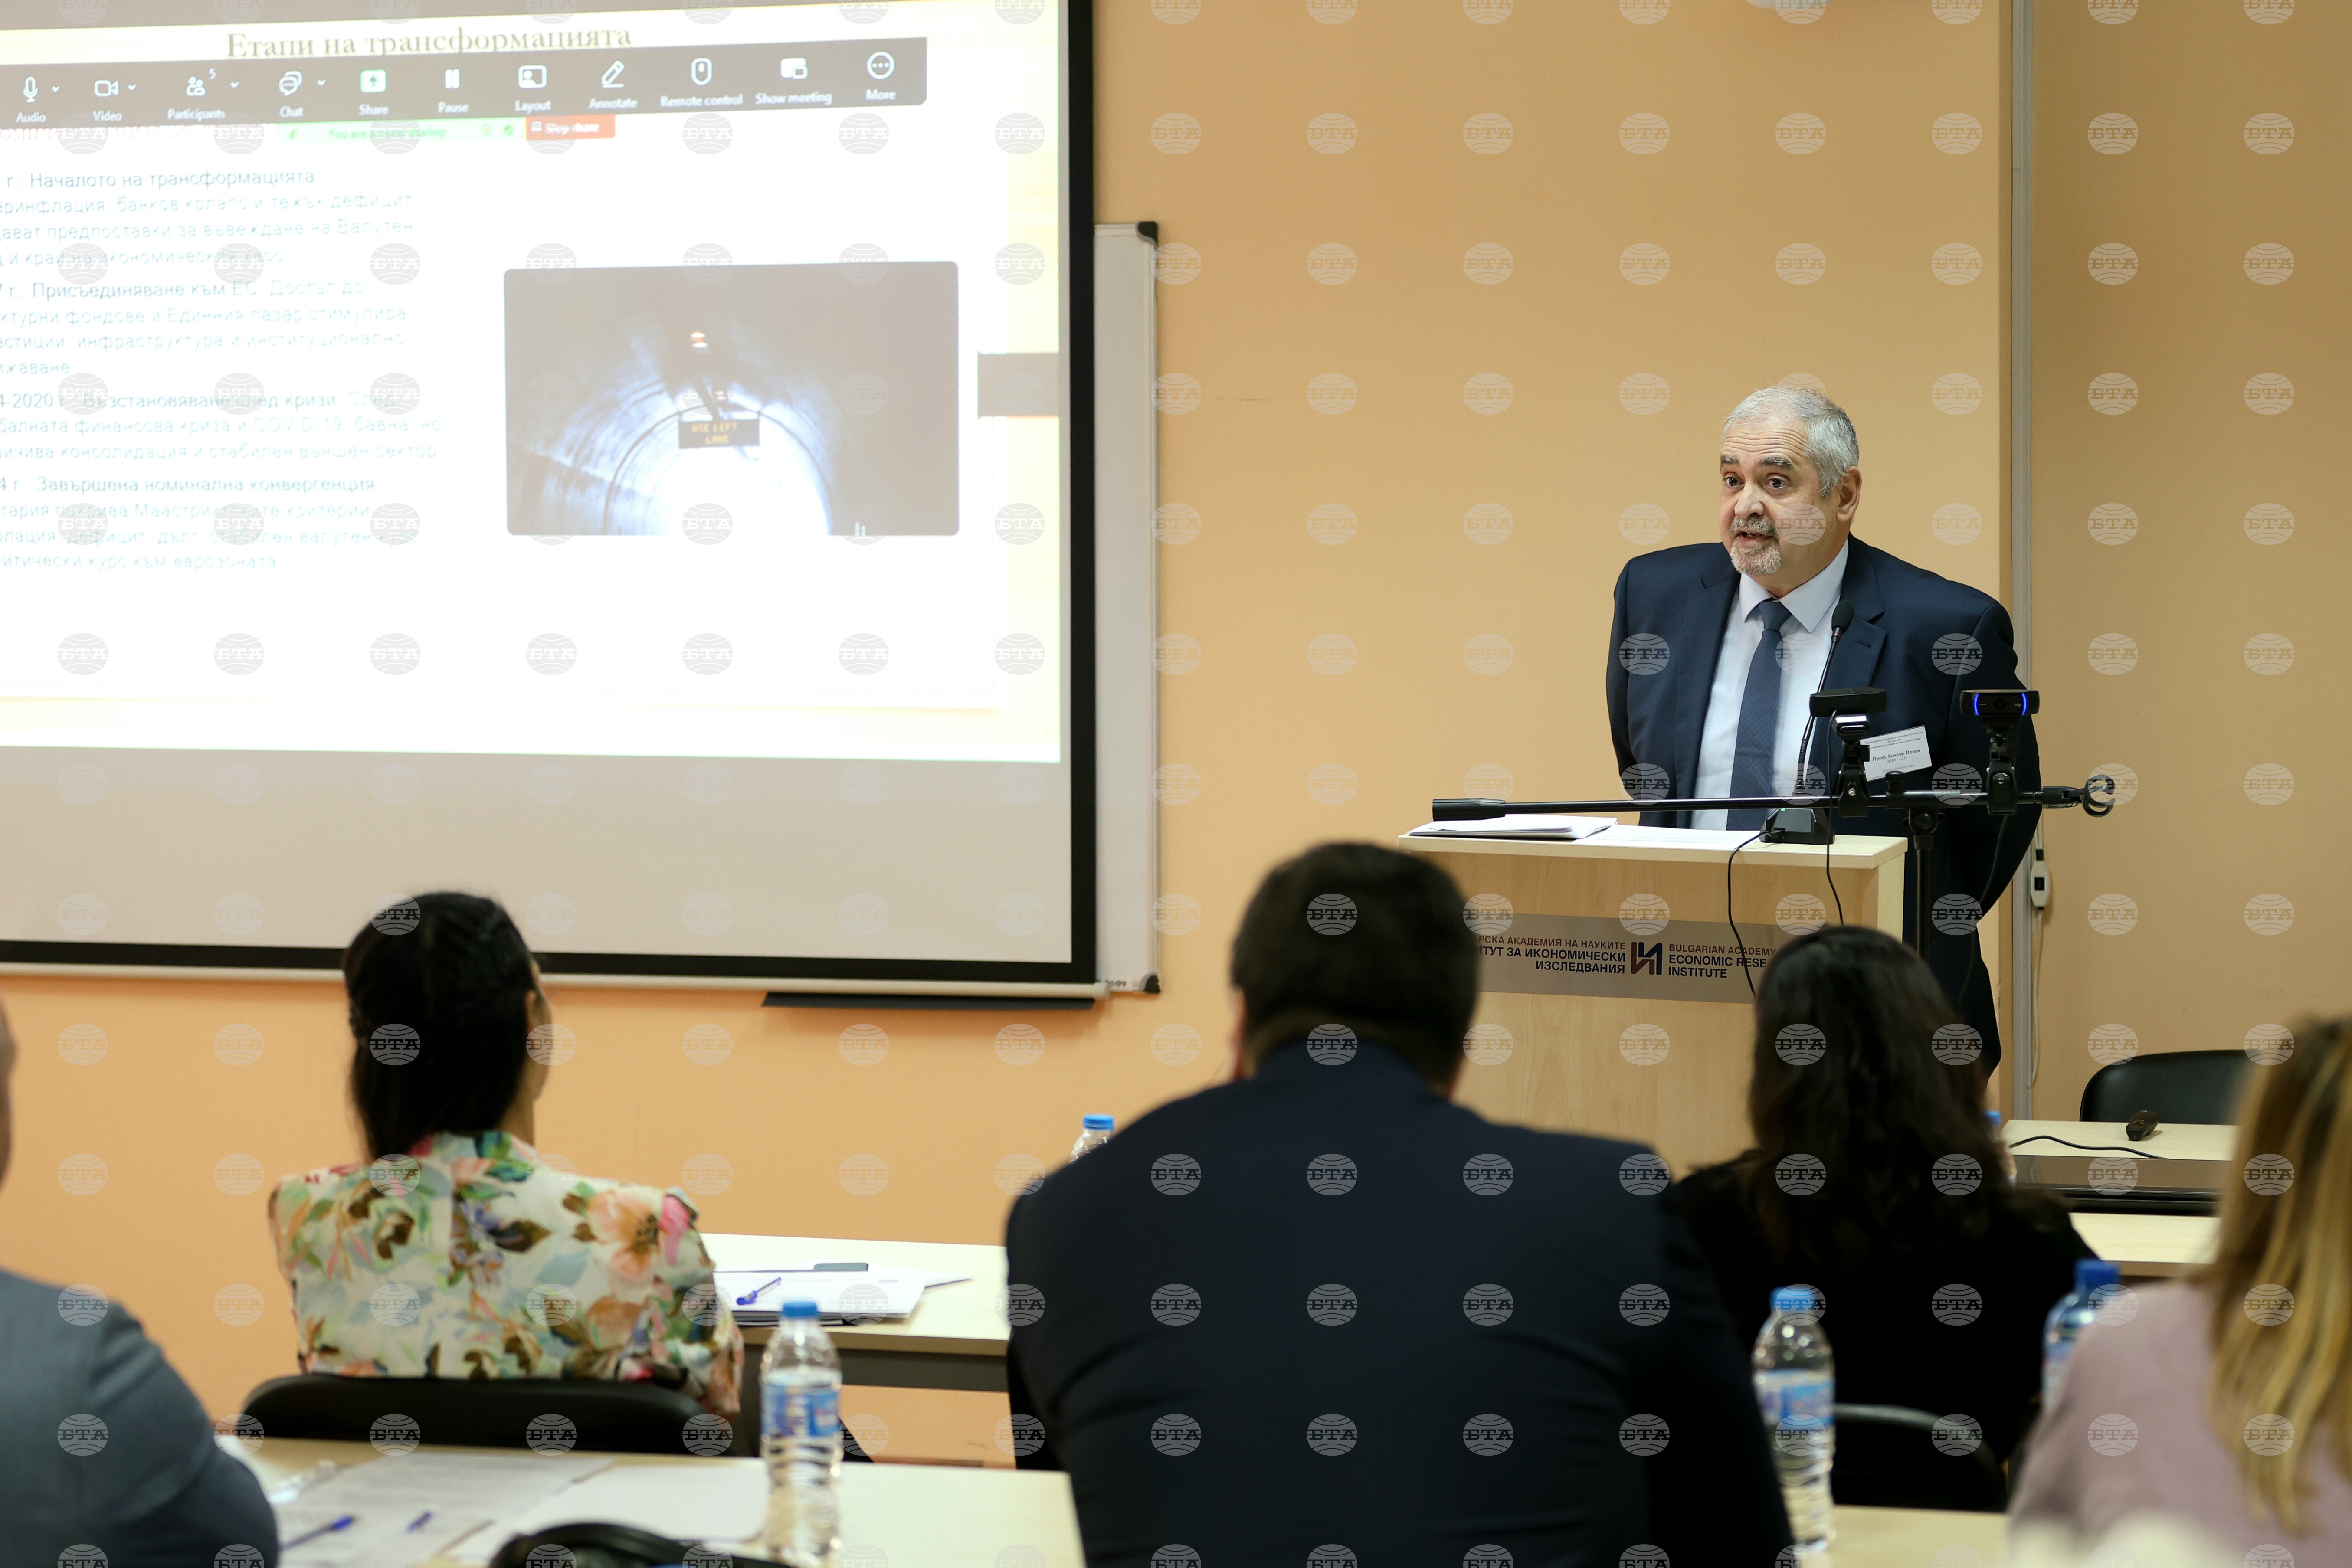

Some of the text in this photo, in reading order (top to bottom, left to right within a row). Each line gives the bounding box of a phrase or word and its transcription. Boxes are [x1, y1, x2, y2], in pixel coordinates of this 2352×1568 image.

[226, 26, 631, 58] Етапи на трансформацията
[661, 93, 743, 108] Remote control
[755, 90, 832, 105] Show meeting
[866, 89, 897, 101] More
[359, 103, 389, 115] Share
[438, 101, 469, 113] Pause
[515, 100, 552, 114] Layout
[589, 97, 638, 110] Annotate
[16, 112, 47, 123] Audio
[93, 110, 123, 121] Video
[167, 108, 226, 122] Participants
[279, 106, 304, 118] Chat
[31, 172, 116, 188] Началото
[122, 173, 142, 186] на
[0, 193, 412, 216] ринфлация банков колапс и тежък дефицит
[0, 219, 413, 242] ават предпоставки за въвеждане на Валутен
[10, 252, 19, 265] и
[33, 282, 185, 302] Присъединяване
[192, 284, 225, 297] към
[270, 279, 335, 298] Достъп
[342, 281, 364, 296] до
[1, 307, 406, 328] ктурни фондове и Единния пазар стимулира
[78, 334, 223, 353] инфраструктура
[230, 335, 239, 347] и
[247, 332, 405, 351] институционално
[0, 417, 69, 433] балната
[75, 418, 174, 437] финансова
[180, 419, 230, 437] криза
[237, 420, 246, 432] и
[421, 419, 442, 432] но
[0, 442, 54, 459] йчива
[61, 446, 187, 461] консолидация
[194, 446, 203, 458] и
[210, 442, 293, 459] стабилен
[300, 445, 369, 459] външен
[37, 475, 138, 496] Завършена
[145, 479, 243, 492] номинална
[1, 504, 49, 521] гария
[300, 530, 371, 548] валутен
[0, 555, 277, 573] итически курс към еврозоната
[1478, 935, 1504, 944] РСКА
[1507, 936, 1562, 947] АКАДЕМИЯ
[1581, 940, 1626, 950] НАУКИТЕ
[1669, 944, 1776, 956] BULGARIAN ACADEMY
[1477, 946, 1625, 962] ТУТ ЗА ИКОНОМИЧЕСКИ
[1669, 954, 1767, 968] ECONOMIC RESE
[1536, 960, 1625, 974] ИЗСЛЕДВАНИЯ
[1668, 966, 1727, 978] INSTITUTE
